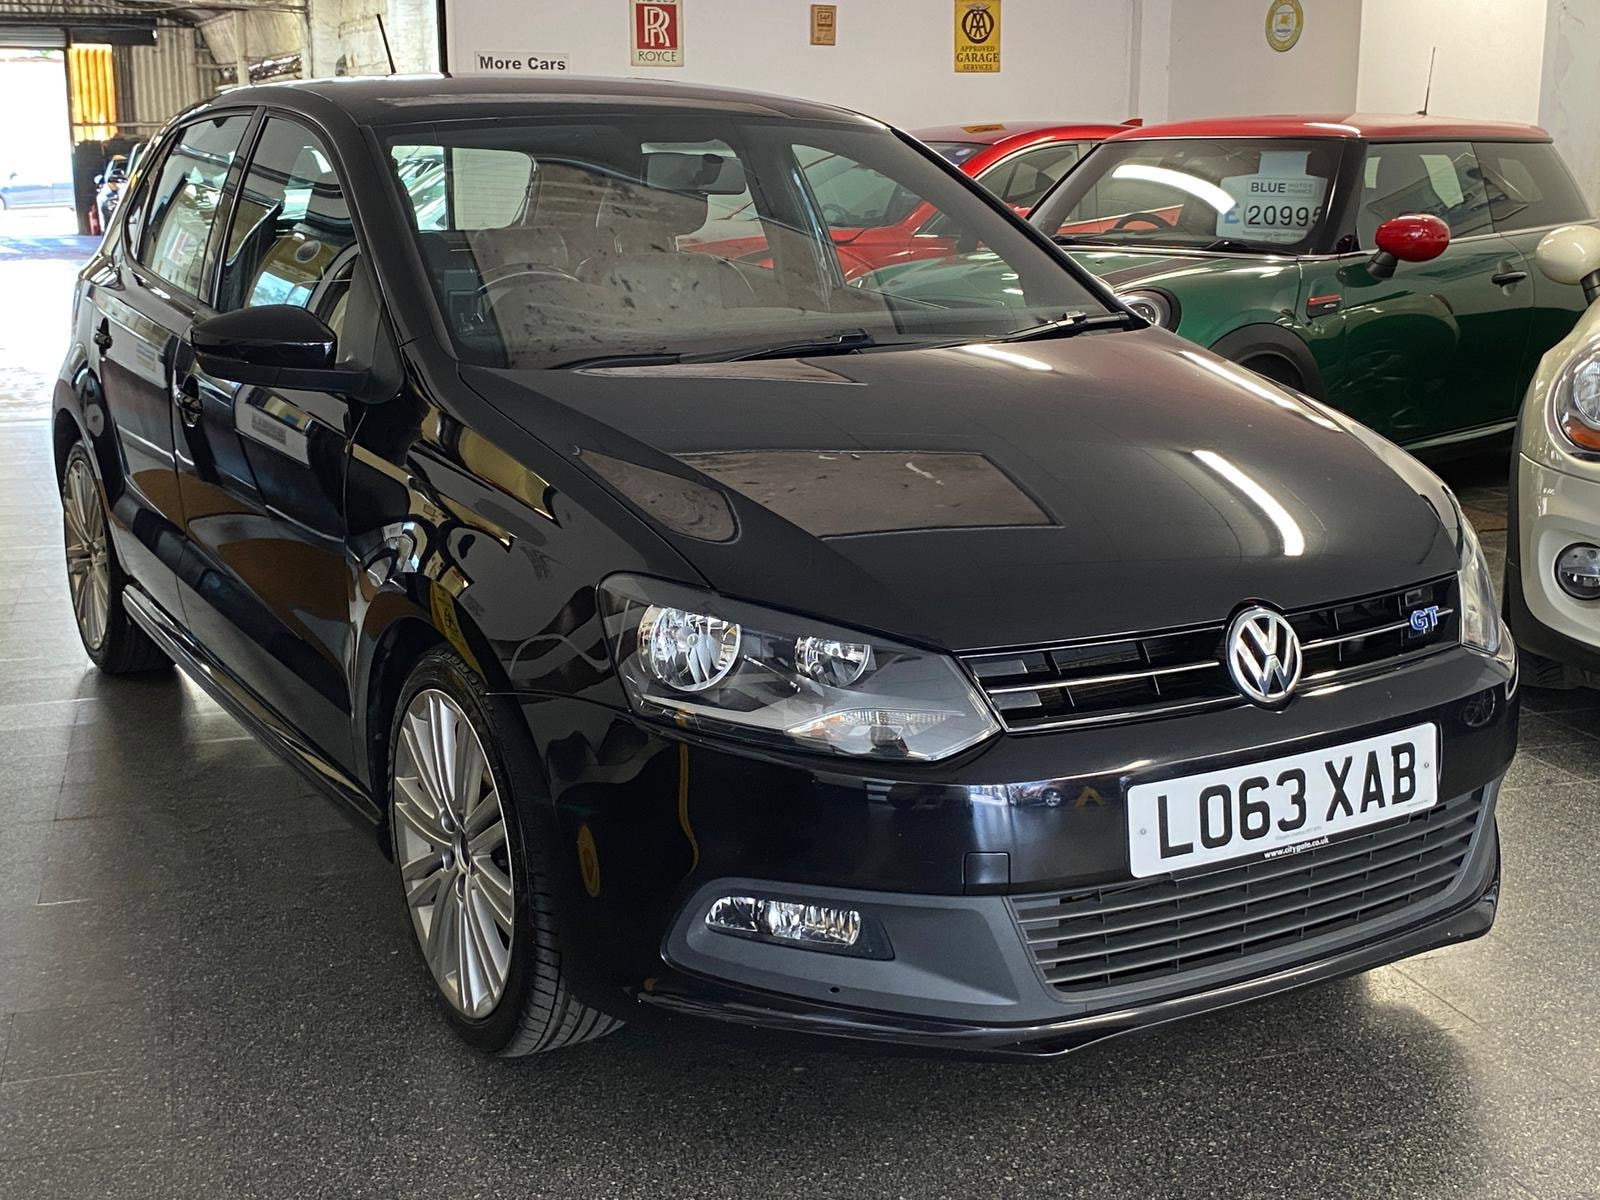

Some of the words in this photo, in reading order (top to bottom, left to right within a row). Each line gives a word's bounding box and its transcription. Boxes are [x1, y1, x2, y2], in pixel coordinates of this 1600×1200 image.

[960, 45, 995, 53] APPROVED
[638, 50, 677, 62] ROYCE
[956, 52, 1000, 63] GARAGE
[479, 55, 523, 70] More
[527, 55, 567, 71] Cars
[963, 63, 993, 71] SERVICES
[1250, 181, 1286, 193] BLUE
[1410, 605, 1440, 631] GT
[1157, 768, 1307, 859] LO63
[1324, 741, 1416, 822] XAB
[1263, 835, 1330, 858] www.citygate.co.uk
